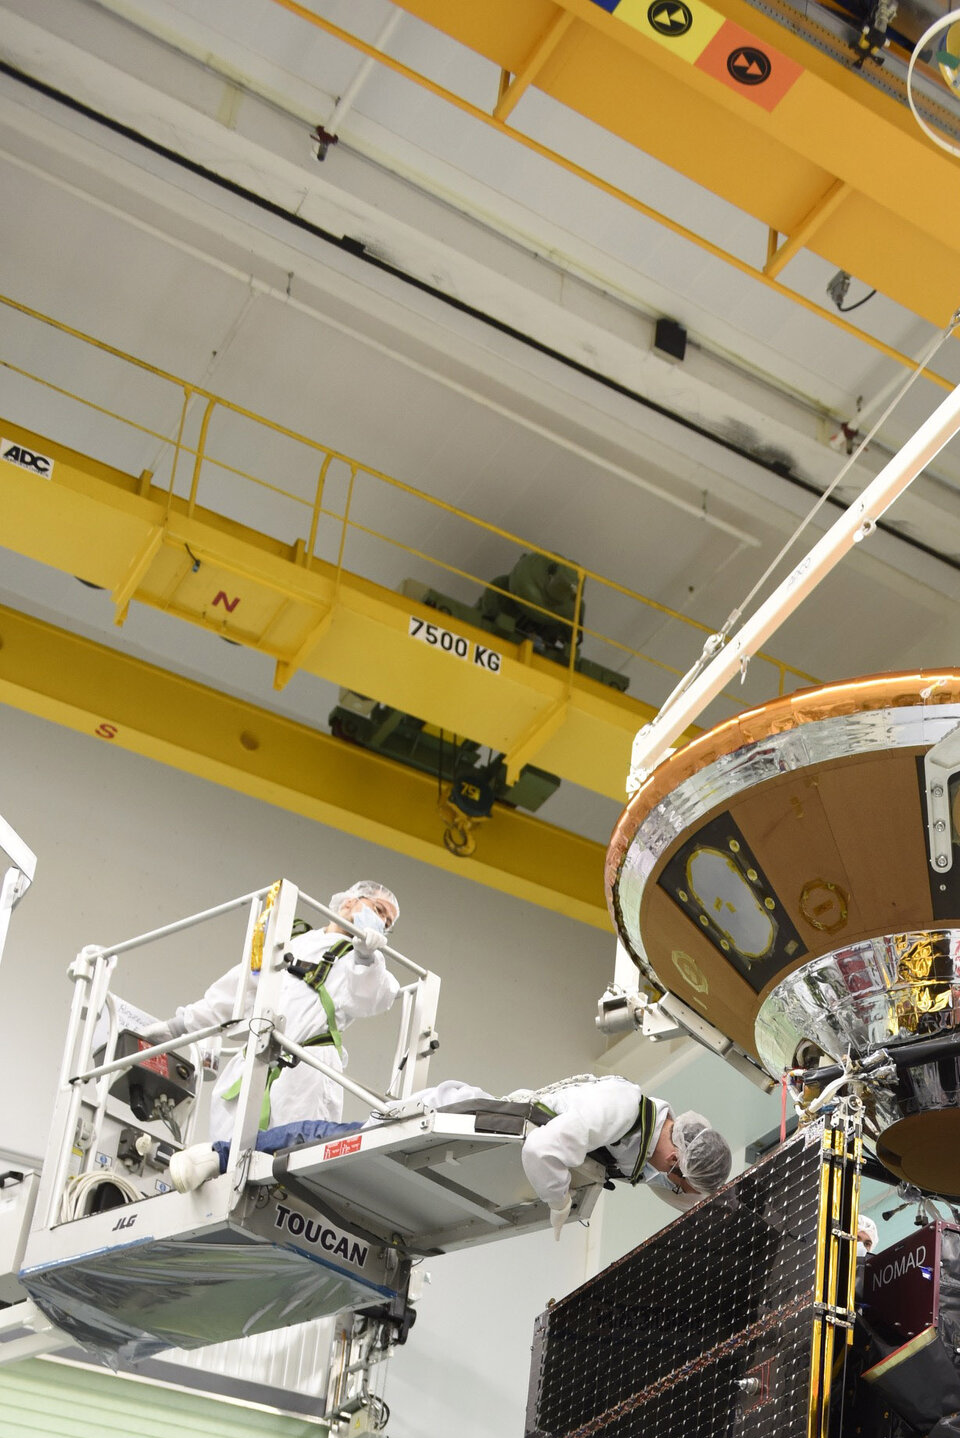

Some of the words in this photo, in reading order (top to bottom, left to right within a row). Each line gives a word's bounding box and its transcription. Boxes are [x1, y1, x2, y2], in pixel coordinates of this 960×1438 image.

[4, 446, 50, 472] ADC
[211, 591, 241, 613] N
[411, 617, 468, 657] 7500
[474, 645, 501, 672] KG
[95, 723, 118, 739] S
[112, 1214, 138, 1231] JLG
[274, 1203, 369, 1268] TOUCAN
[872, 1245, 927, 1292] NOMAD
